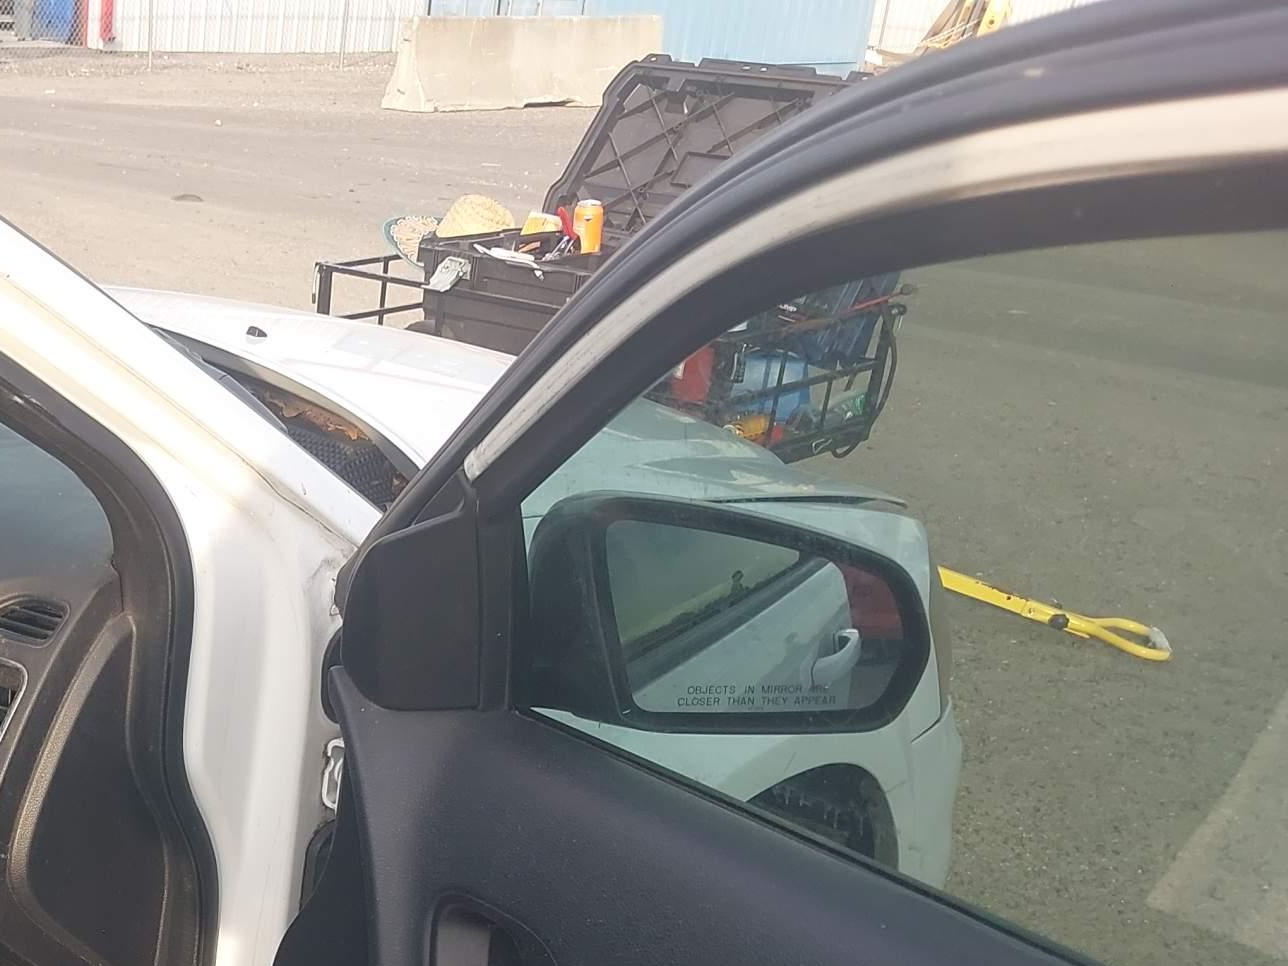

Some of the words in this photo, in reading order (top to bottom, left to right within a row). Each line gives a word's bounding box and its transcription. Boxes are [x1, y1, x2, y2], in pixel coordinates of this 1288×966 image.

[687, 685, 736, 695] OBJECTS
[744, 685, 755, 694] IN
[761, 685, 802, 694] MIRROR
[677, 696, 720, 706] CLOSER
[727, 696, 755, 706] THAN
[761, 696, 787, 705] THEY
[794, 695, 836, 705] APPEAR
